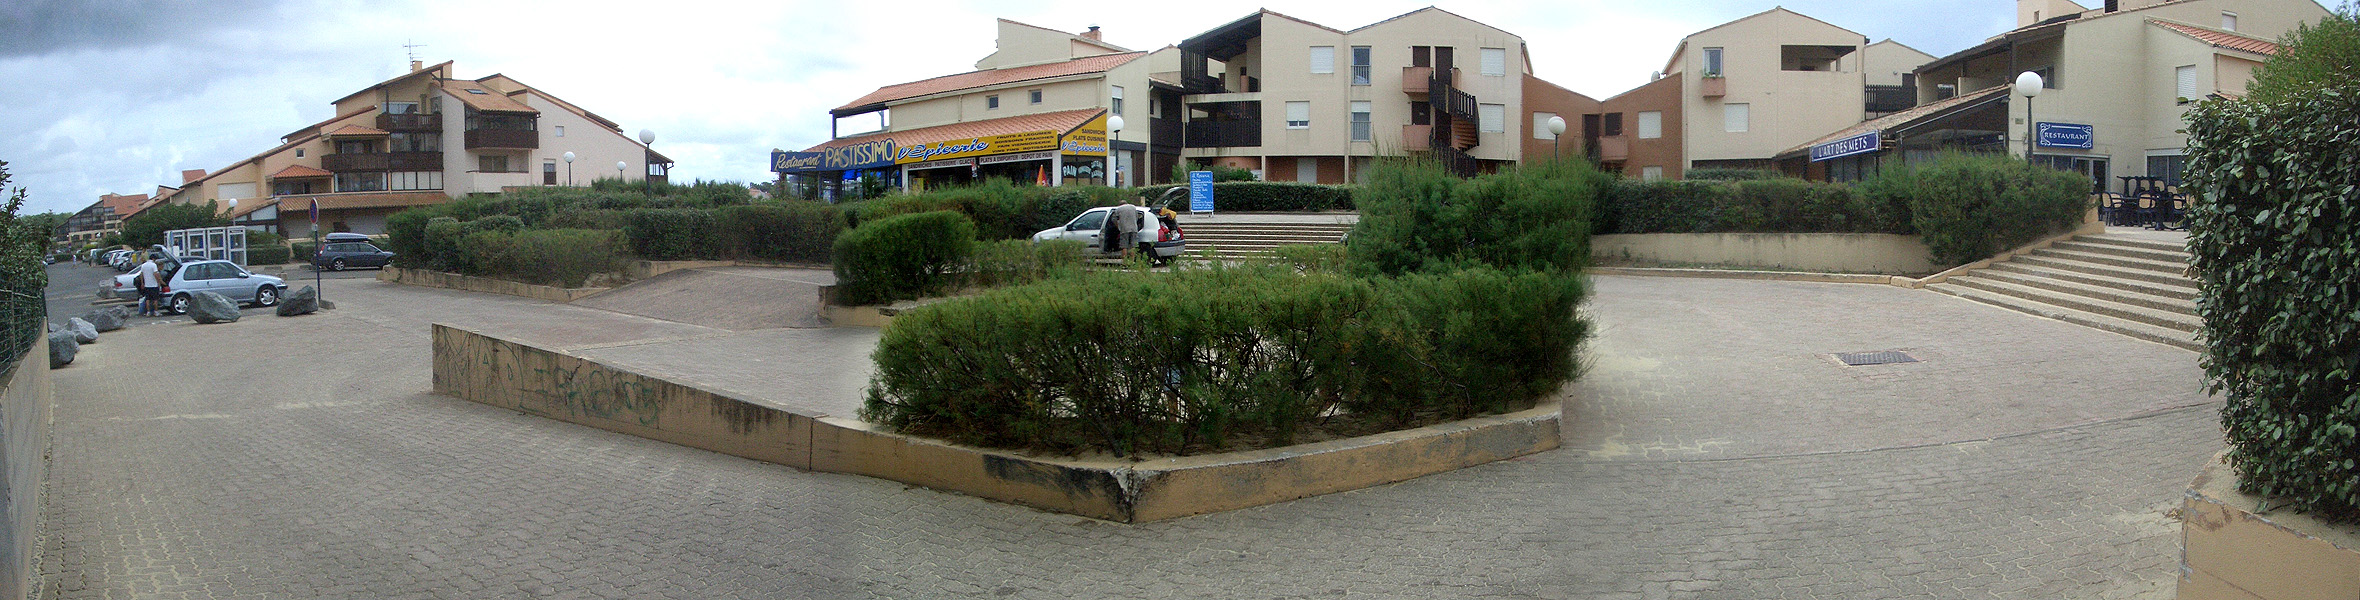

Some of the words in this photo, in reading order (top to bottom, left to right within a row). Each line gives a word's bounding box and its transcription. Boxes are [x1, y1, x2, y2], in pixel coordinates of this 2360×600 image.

[2044, 132, 2088, 140] RESTAURANT
[775, 153, 822, 171] Restaurant
[825, 138, 895, 168] PASTISSIMO
[1819, 144, 1834, 157] L'ART
[1835, 141, 1847, 154] DES
[1849, 137, 1867, 150] METS
